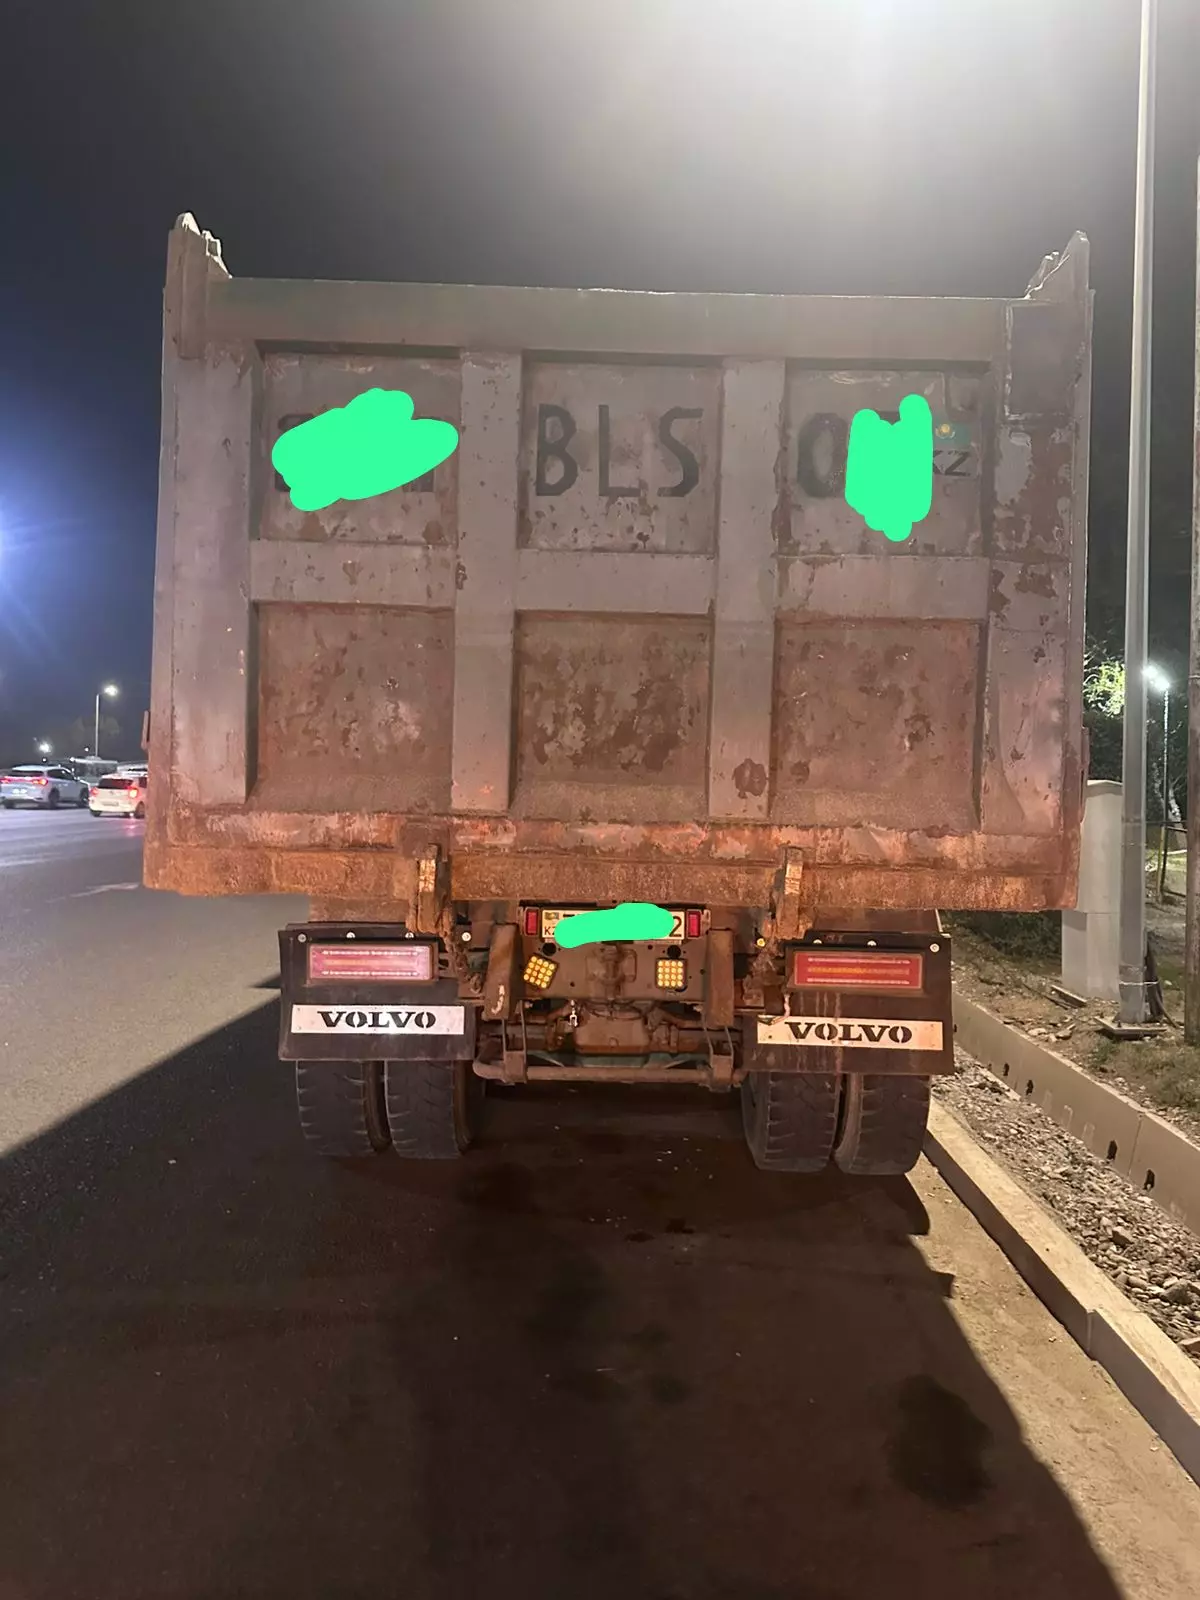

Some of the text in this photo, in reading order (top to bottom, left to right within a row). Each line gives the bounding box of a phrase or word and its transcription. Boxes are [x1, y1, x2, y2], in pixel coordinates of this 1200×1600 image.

[535, 403, 704, 498] BLS
[317, 1011, 436, 1028] VOLVO
[785, 1022, 912, 1043] VOLVO
